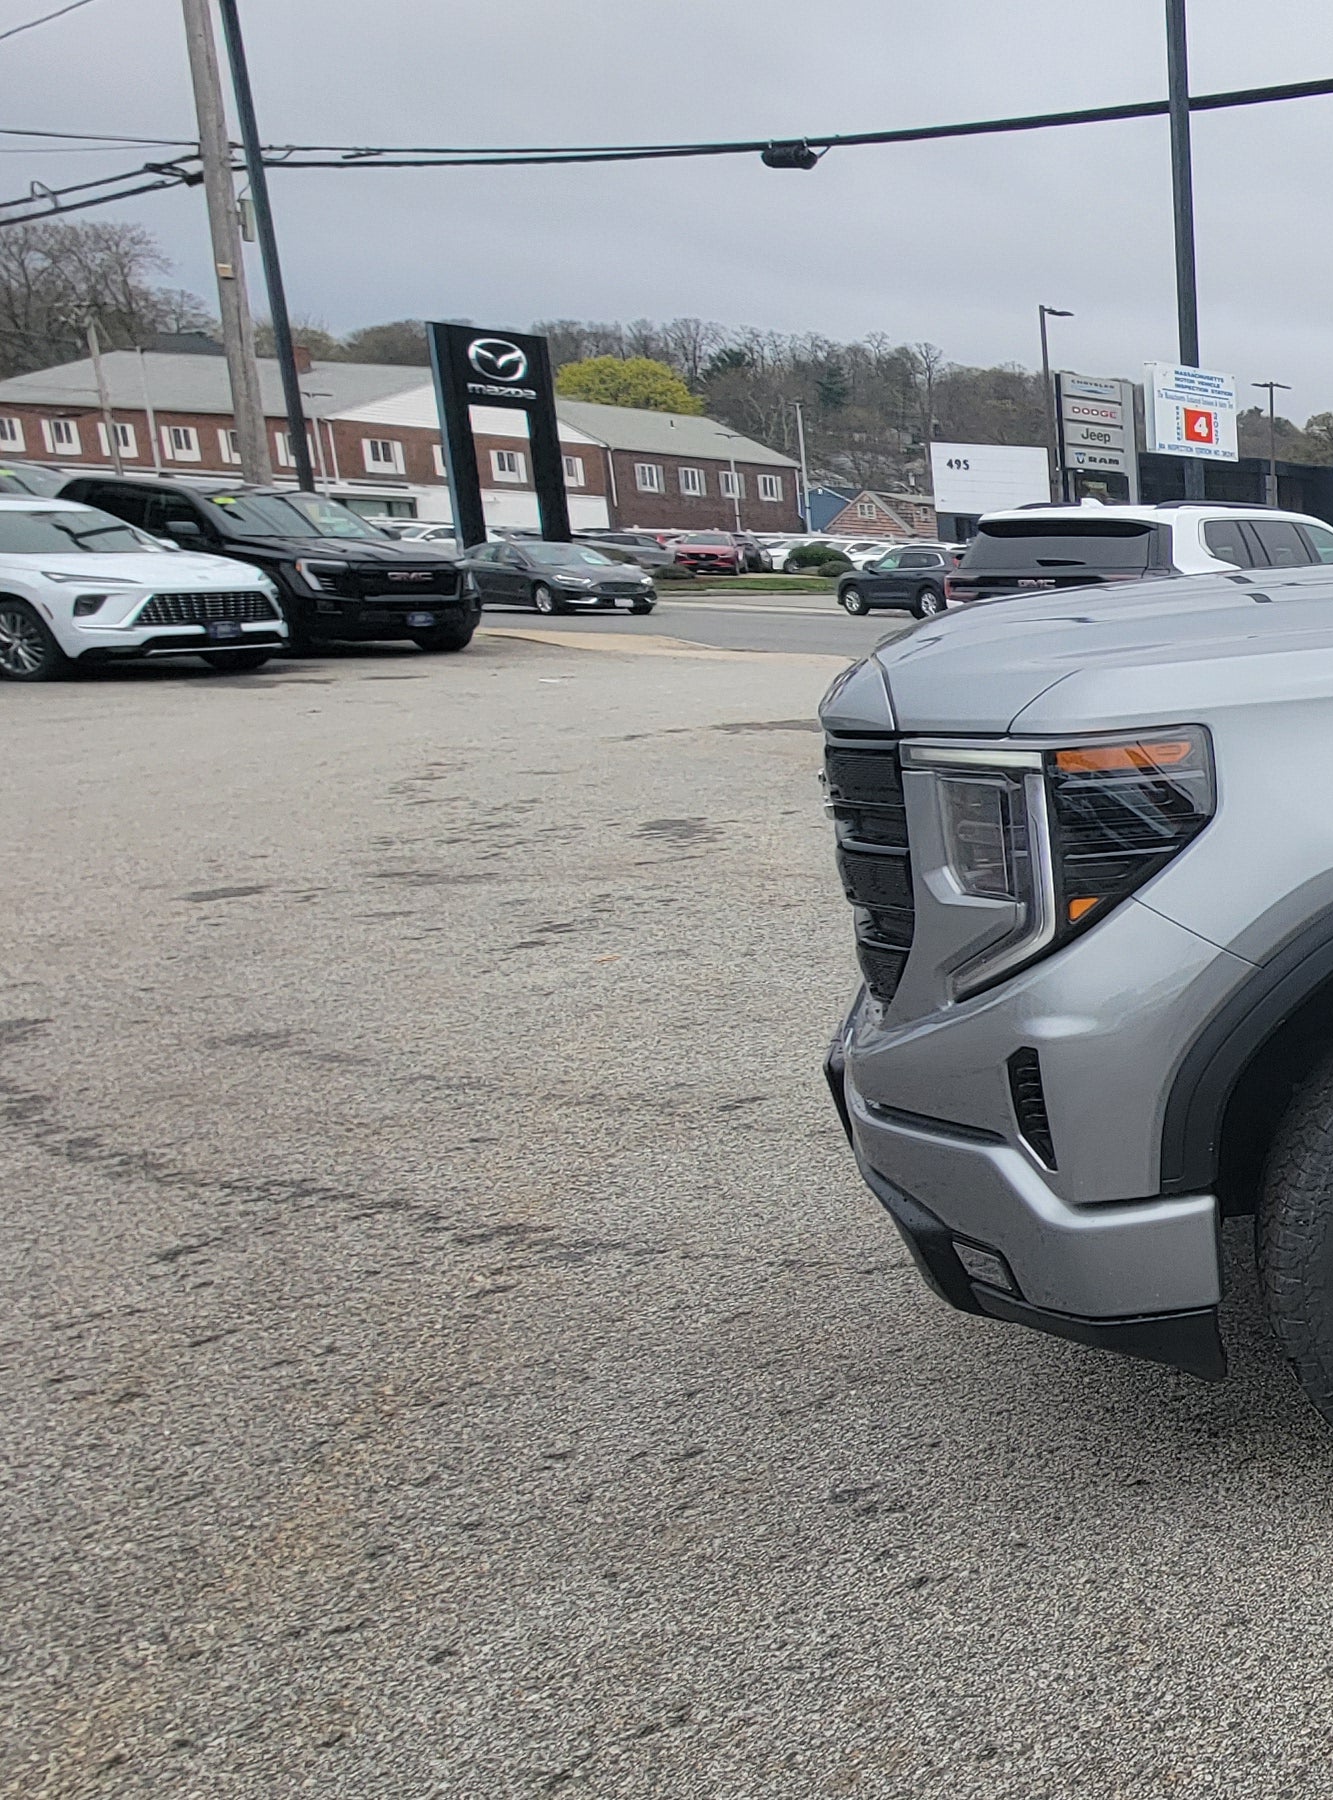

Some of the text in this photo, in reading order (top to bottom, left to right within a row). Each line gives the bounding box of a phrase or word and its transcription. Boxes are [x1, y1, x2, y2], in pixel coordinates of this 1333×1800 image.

[1071, 379, 1115, 389] CHRYSLER
[466, 382, 537, 400] mazda
[1072, 406, 1117, 419] DODGE
[1194, 416, 1209, 437] 4
[1081, 428, 1111, 444] Jeep
[946, 459, 970, 471] 495
[1088, 456, 1120, 466] RAM
